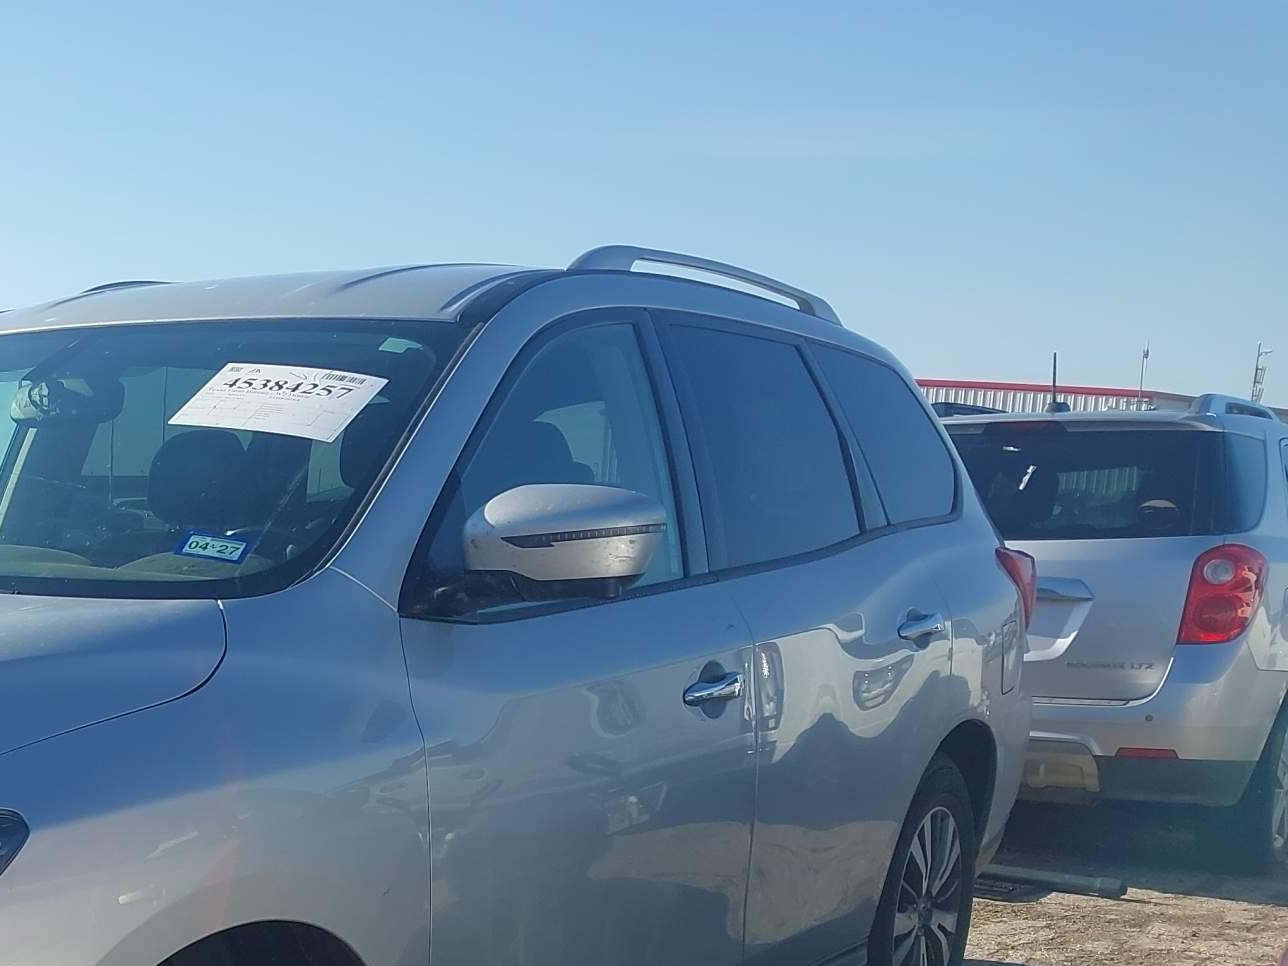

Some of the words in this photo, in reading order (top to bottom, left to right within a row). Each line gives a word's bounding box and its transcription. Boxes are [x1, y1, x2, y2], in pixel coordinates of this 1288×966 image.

[223, 376, 354, 399] 45384257
[188, 540, 209, 552] 04
[216, 544, 241, 556] 27
